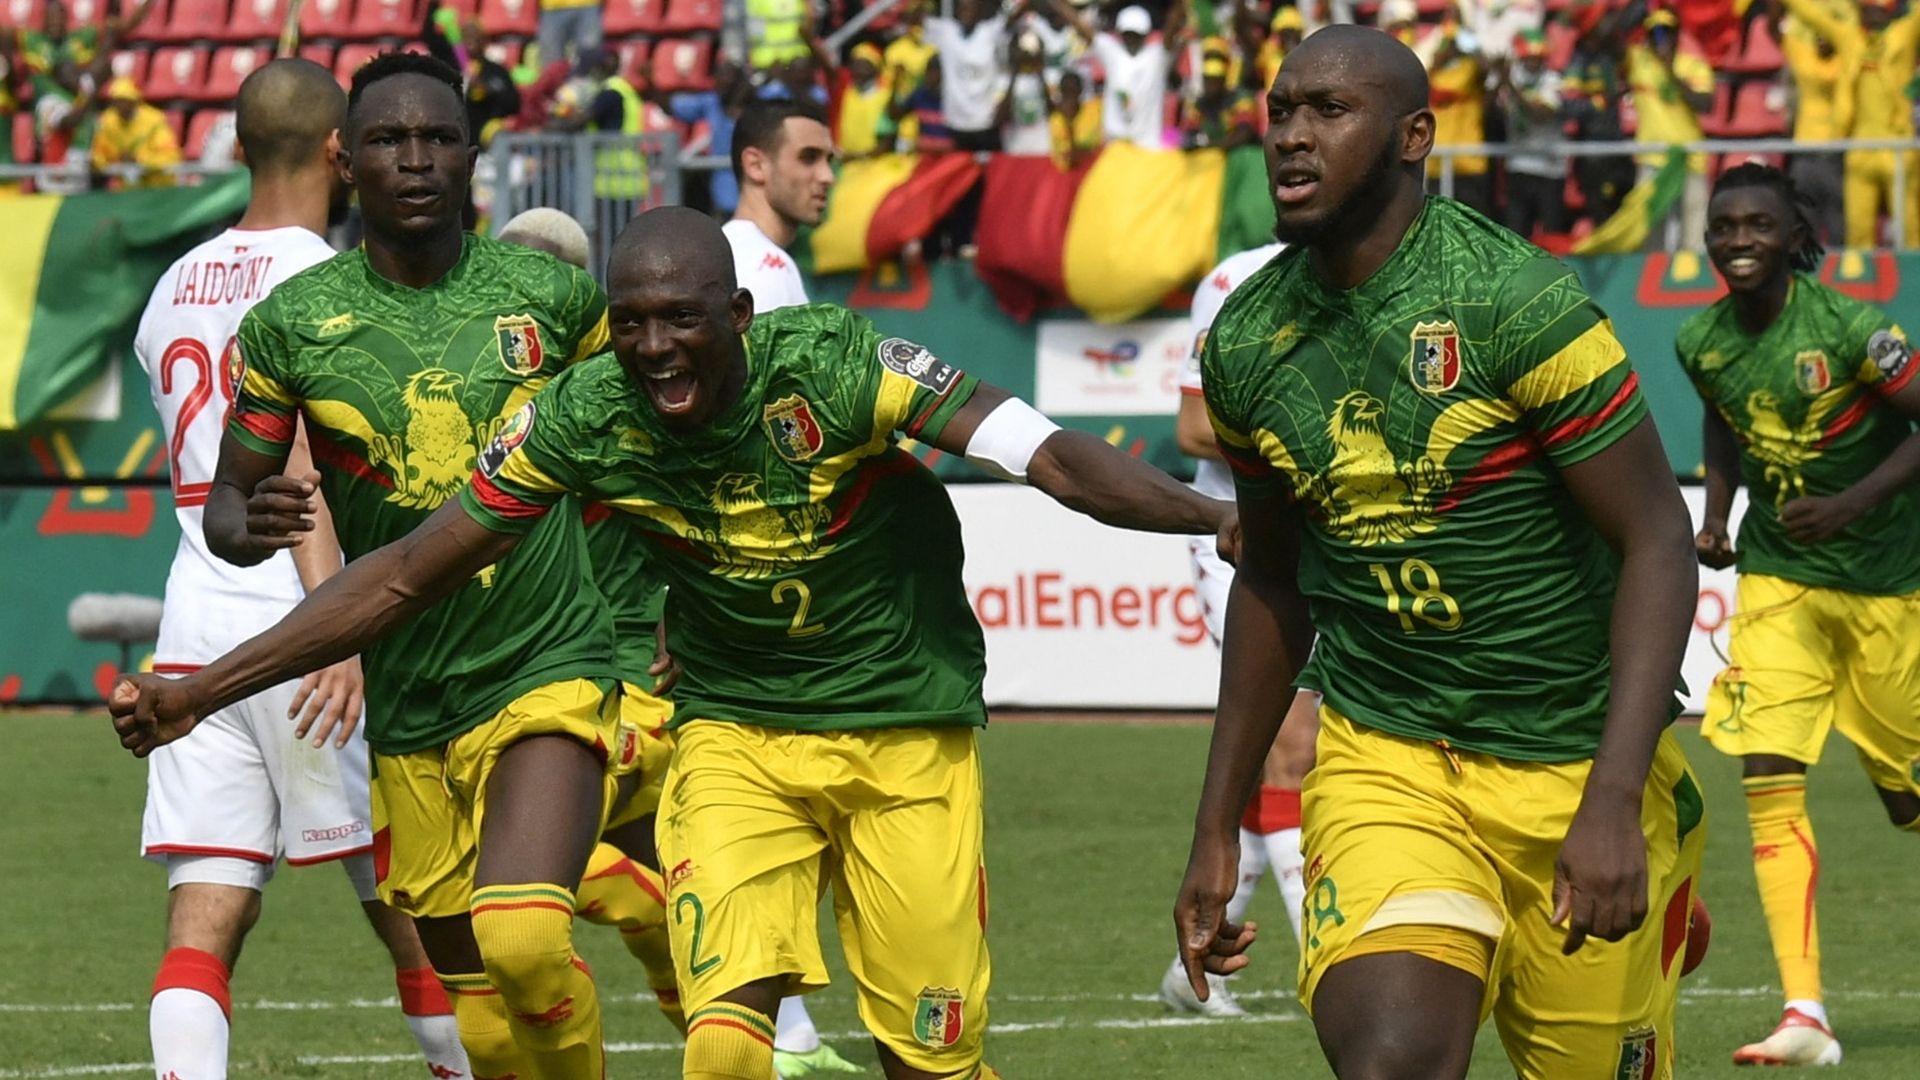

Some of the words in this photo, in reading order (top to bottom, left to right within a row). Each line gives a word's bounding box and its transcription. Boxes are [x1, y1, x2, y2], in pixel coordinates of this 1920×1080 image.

[770, 578, 826, 638] 2
[970, 572, 1208, 646] alEnerg
[1368, 558, 1463, 635] 18
[302, 820, 364, 842] Kappa
[675, 891, 723, 979] 2
